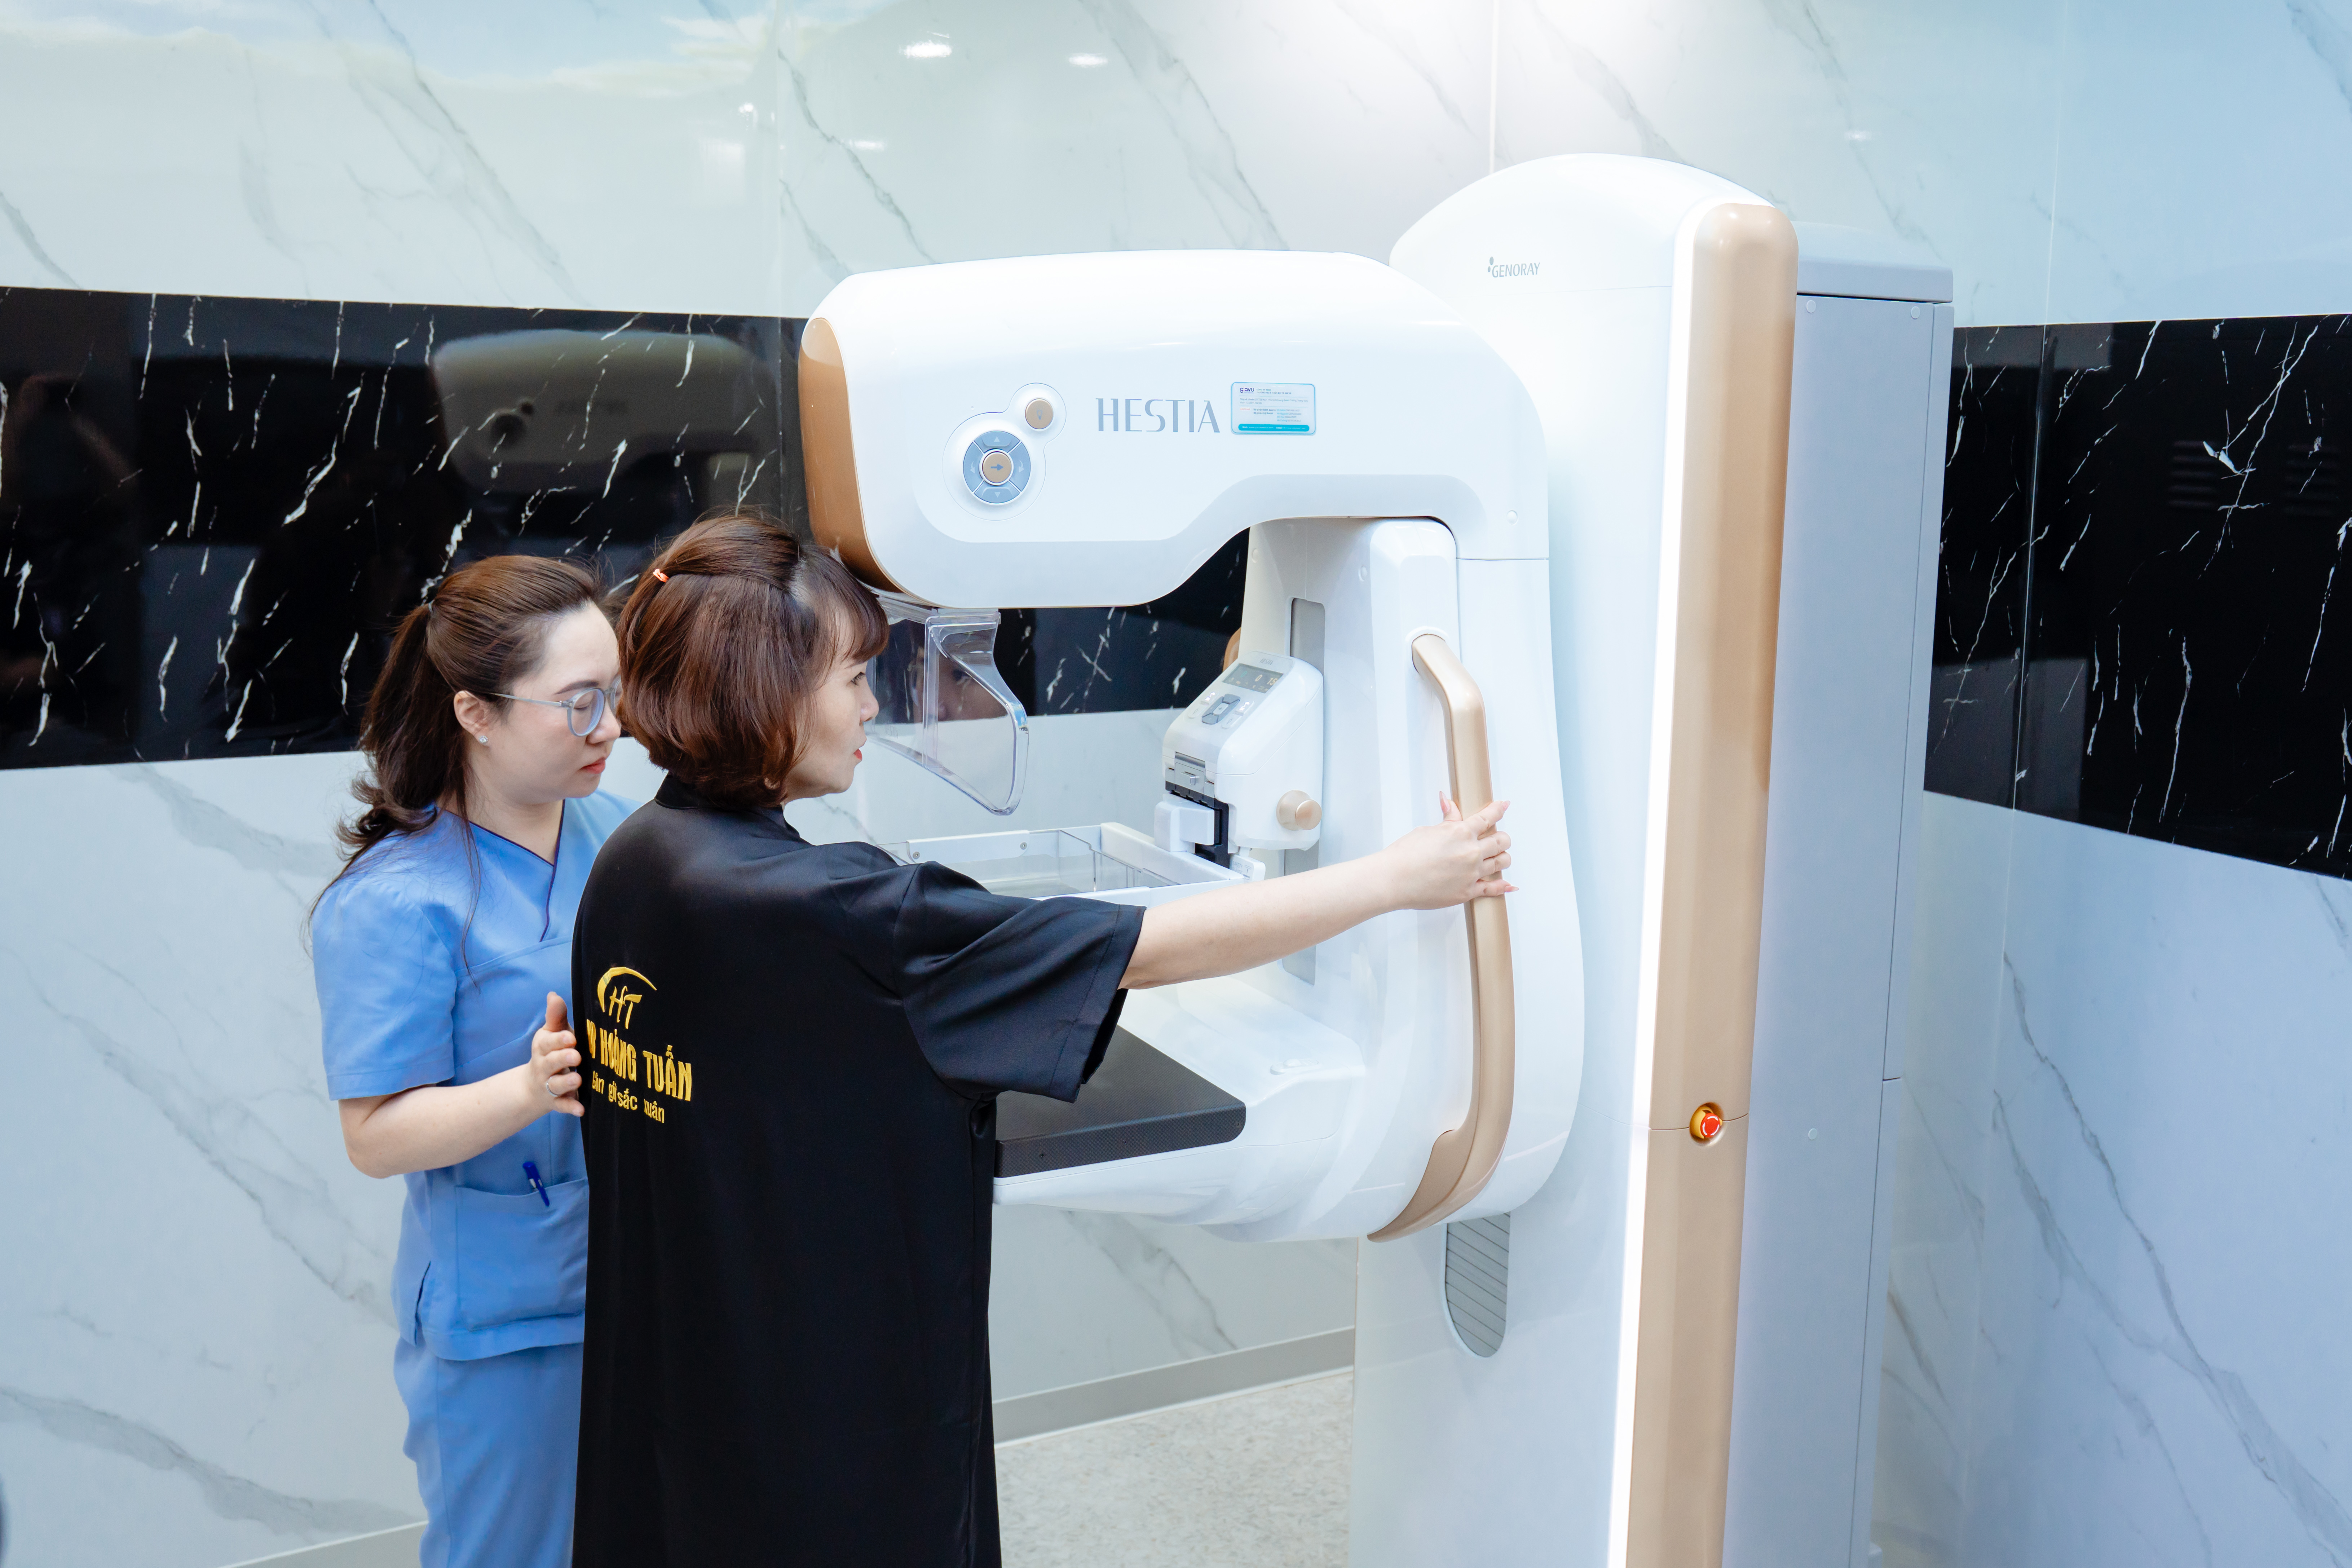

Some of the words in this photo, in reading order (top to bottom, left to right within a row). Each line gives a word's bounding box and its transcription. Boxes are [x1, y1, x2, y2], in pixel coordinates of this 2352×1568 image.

[1492, 262, 1540, 278] GENORAY
[1095, 398, 1220, 433] HESTIA
[884, 724, 898, 739] HESTIA
[600, 1028, 637, 1082] HOÀNG
[643, 1044, 692, 1101] TUẤN
[617, 1088, 638, 1110] sắc
[644, 1098, 665, 1123] xuân
